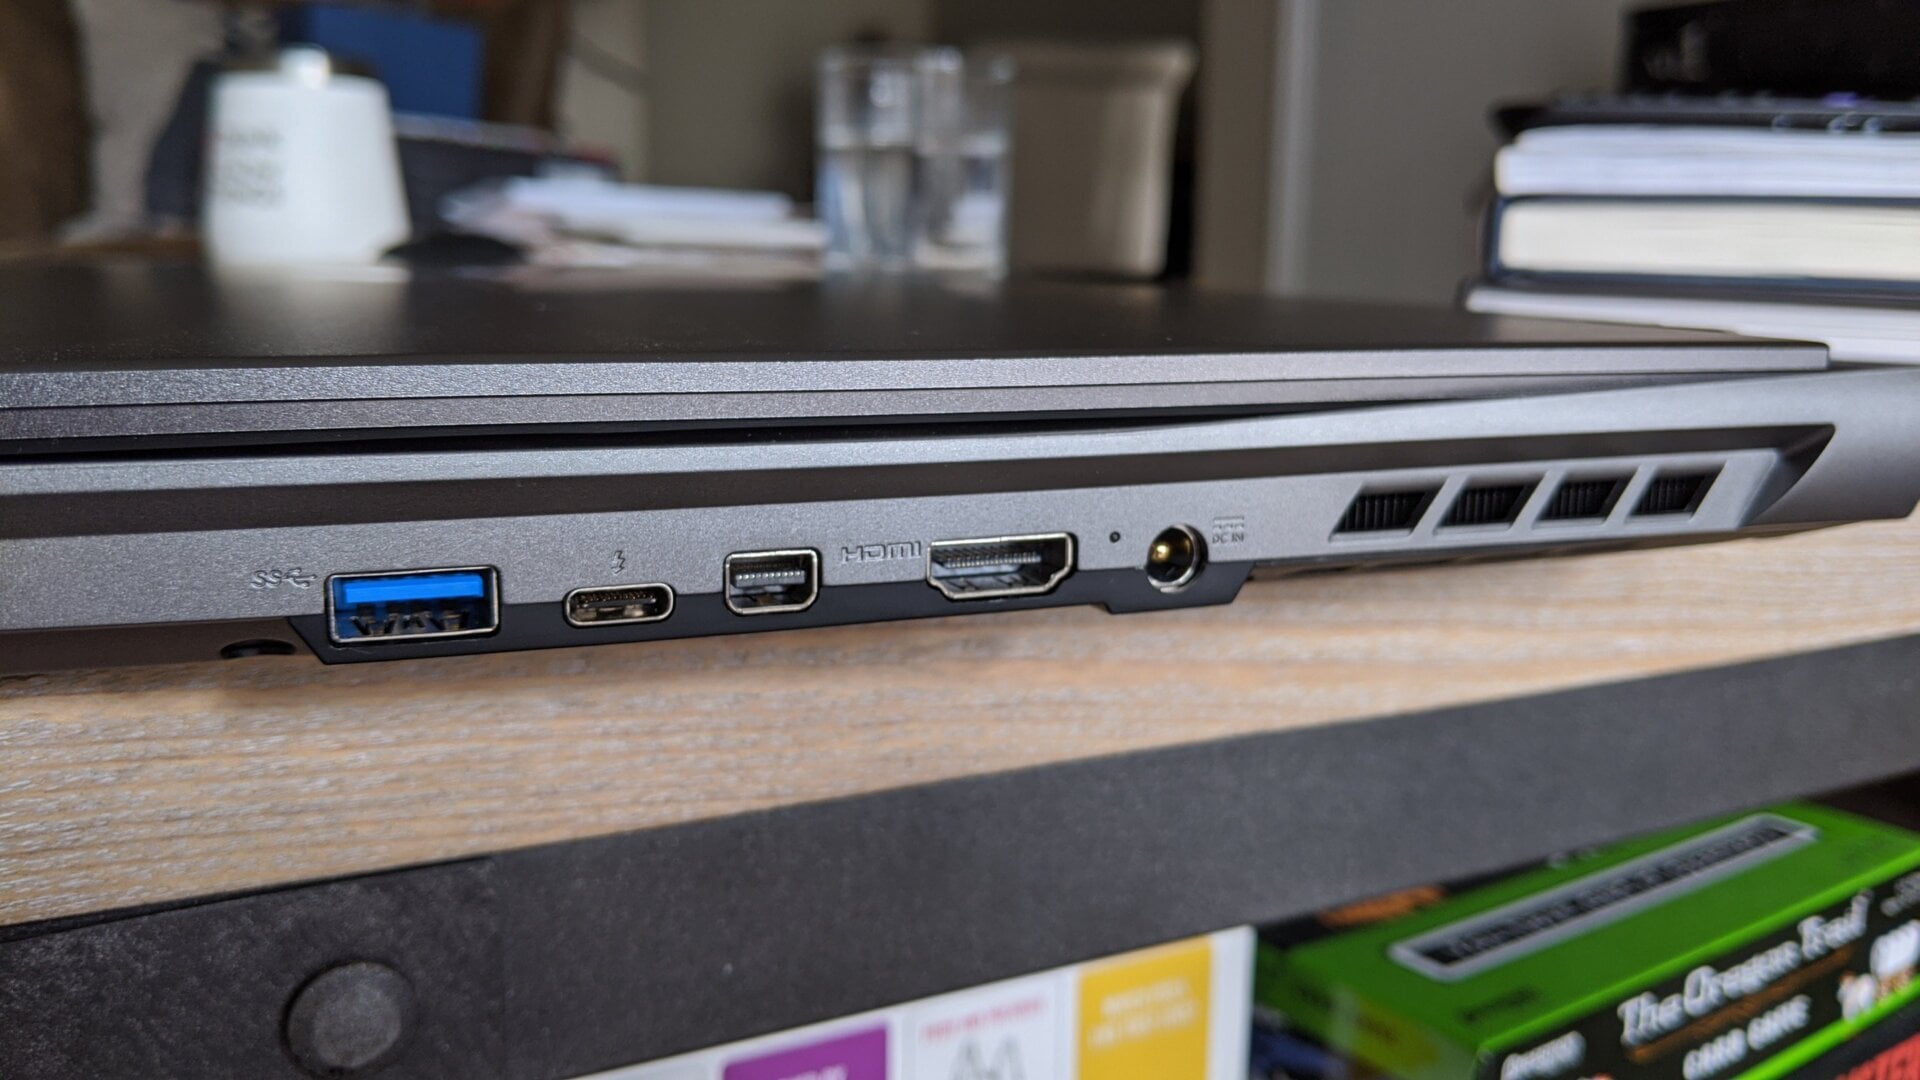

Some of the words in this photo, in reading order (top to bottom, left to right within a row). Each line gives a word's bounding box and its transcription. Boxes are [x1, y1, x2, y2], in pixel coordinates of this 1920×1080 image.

[1211, 532, 1230, 544] DC
[1231, 532, 1245, 543] IN
[841, 541, 922, 564] HDMI
[1617, 990, 1687, 1047] The
[1682, 940, 1801, 1017] Oregon
